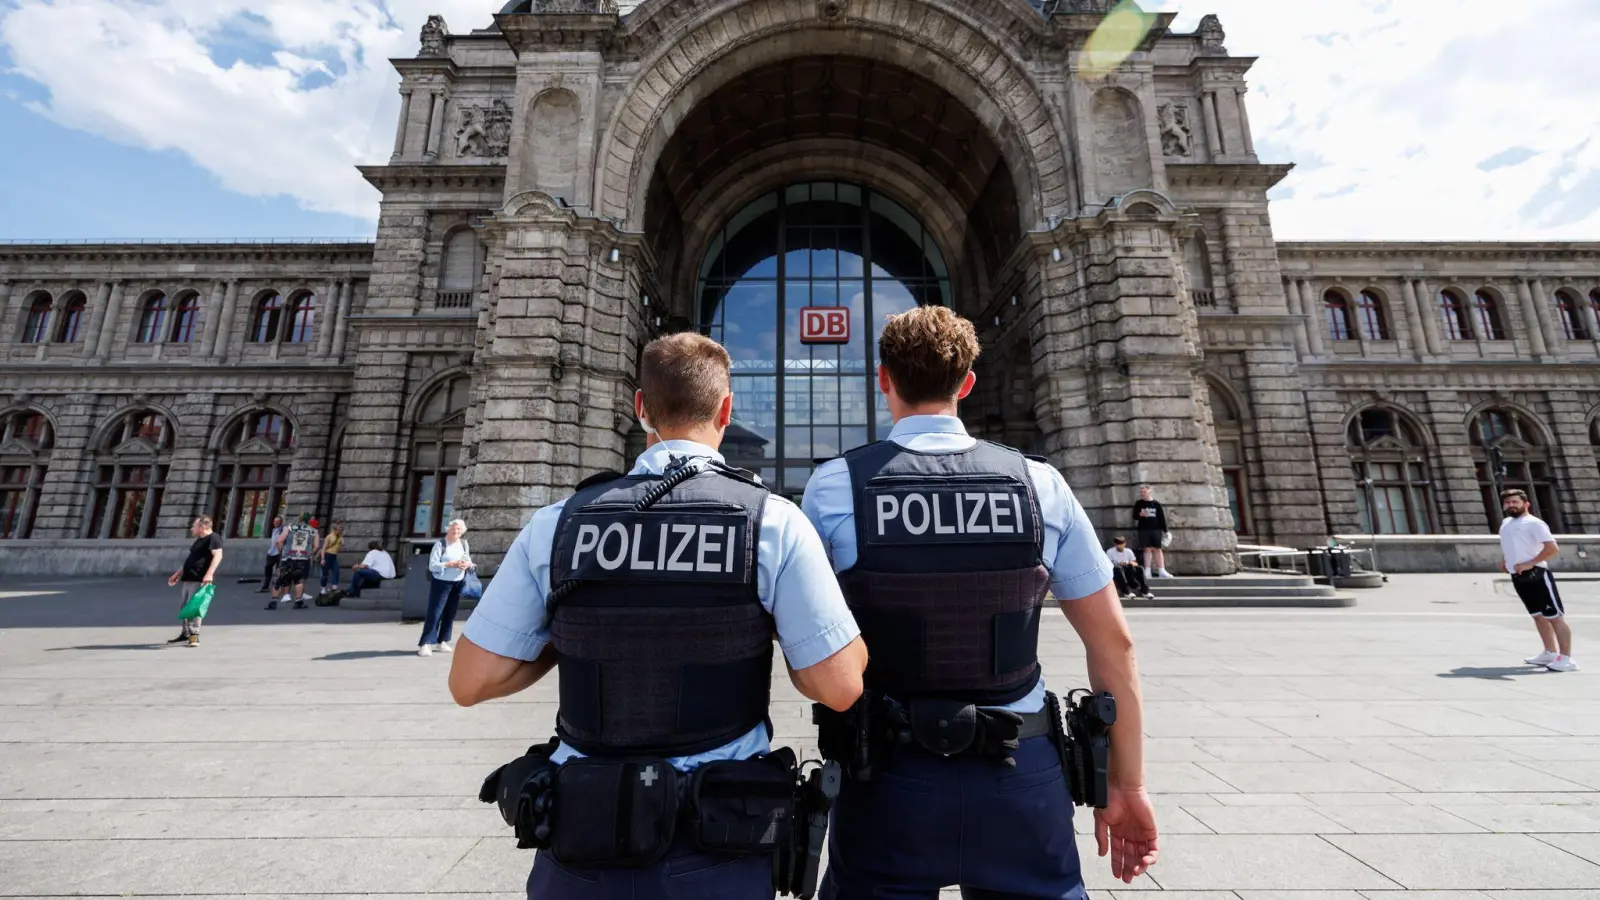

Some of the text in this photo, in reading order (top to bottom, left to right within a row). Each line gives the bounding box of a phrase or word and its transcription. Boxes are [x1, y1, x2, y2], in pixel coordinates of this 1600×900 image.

[807, 312, 845, 336] DB
[876, 492, 1024, 536] POLIZEI
[571, 522, 736, 573] POLIZEI
